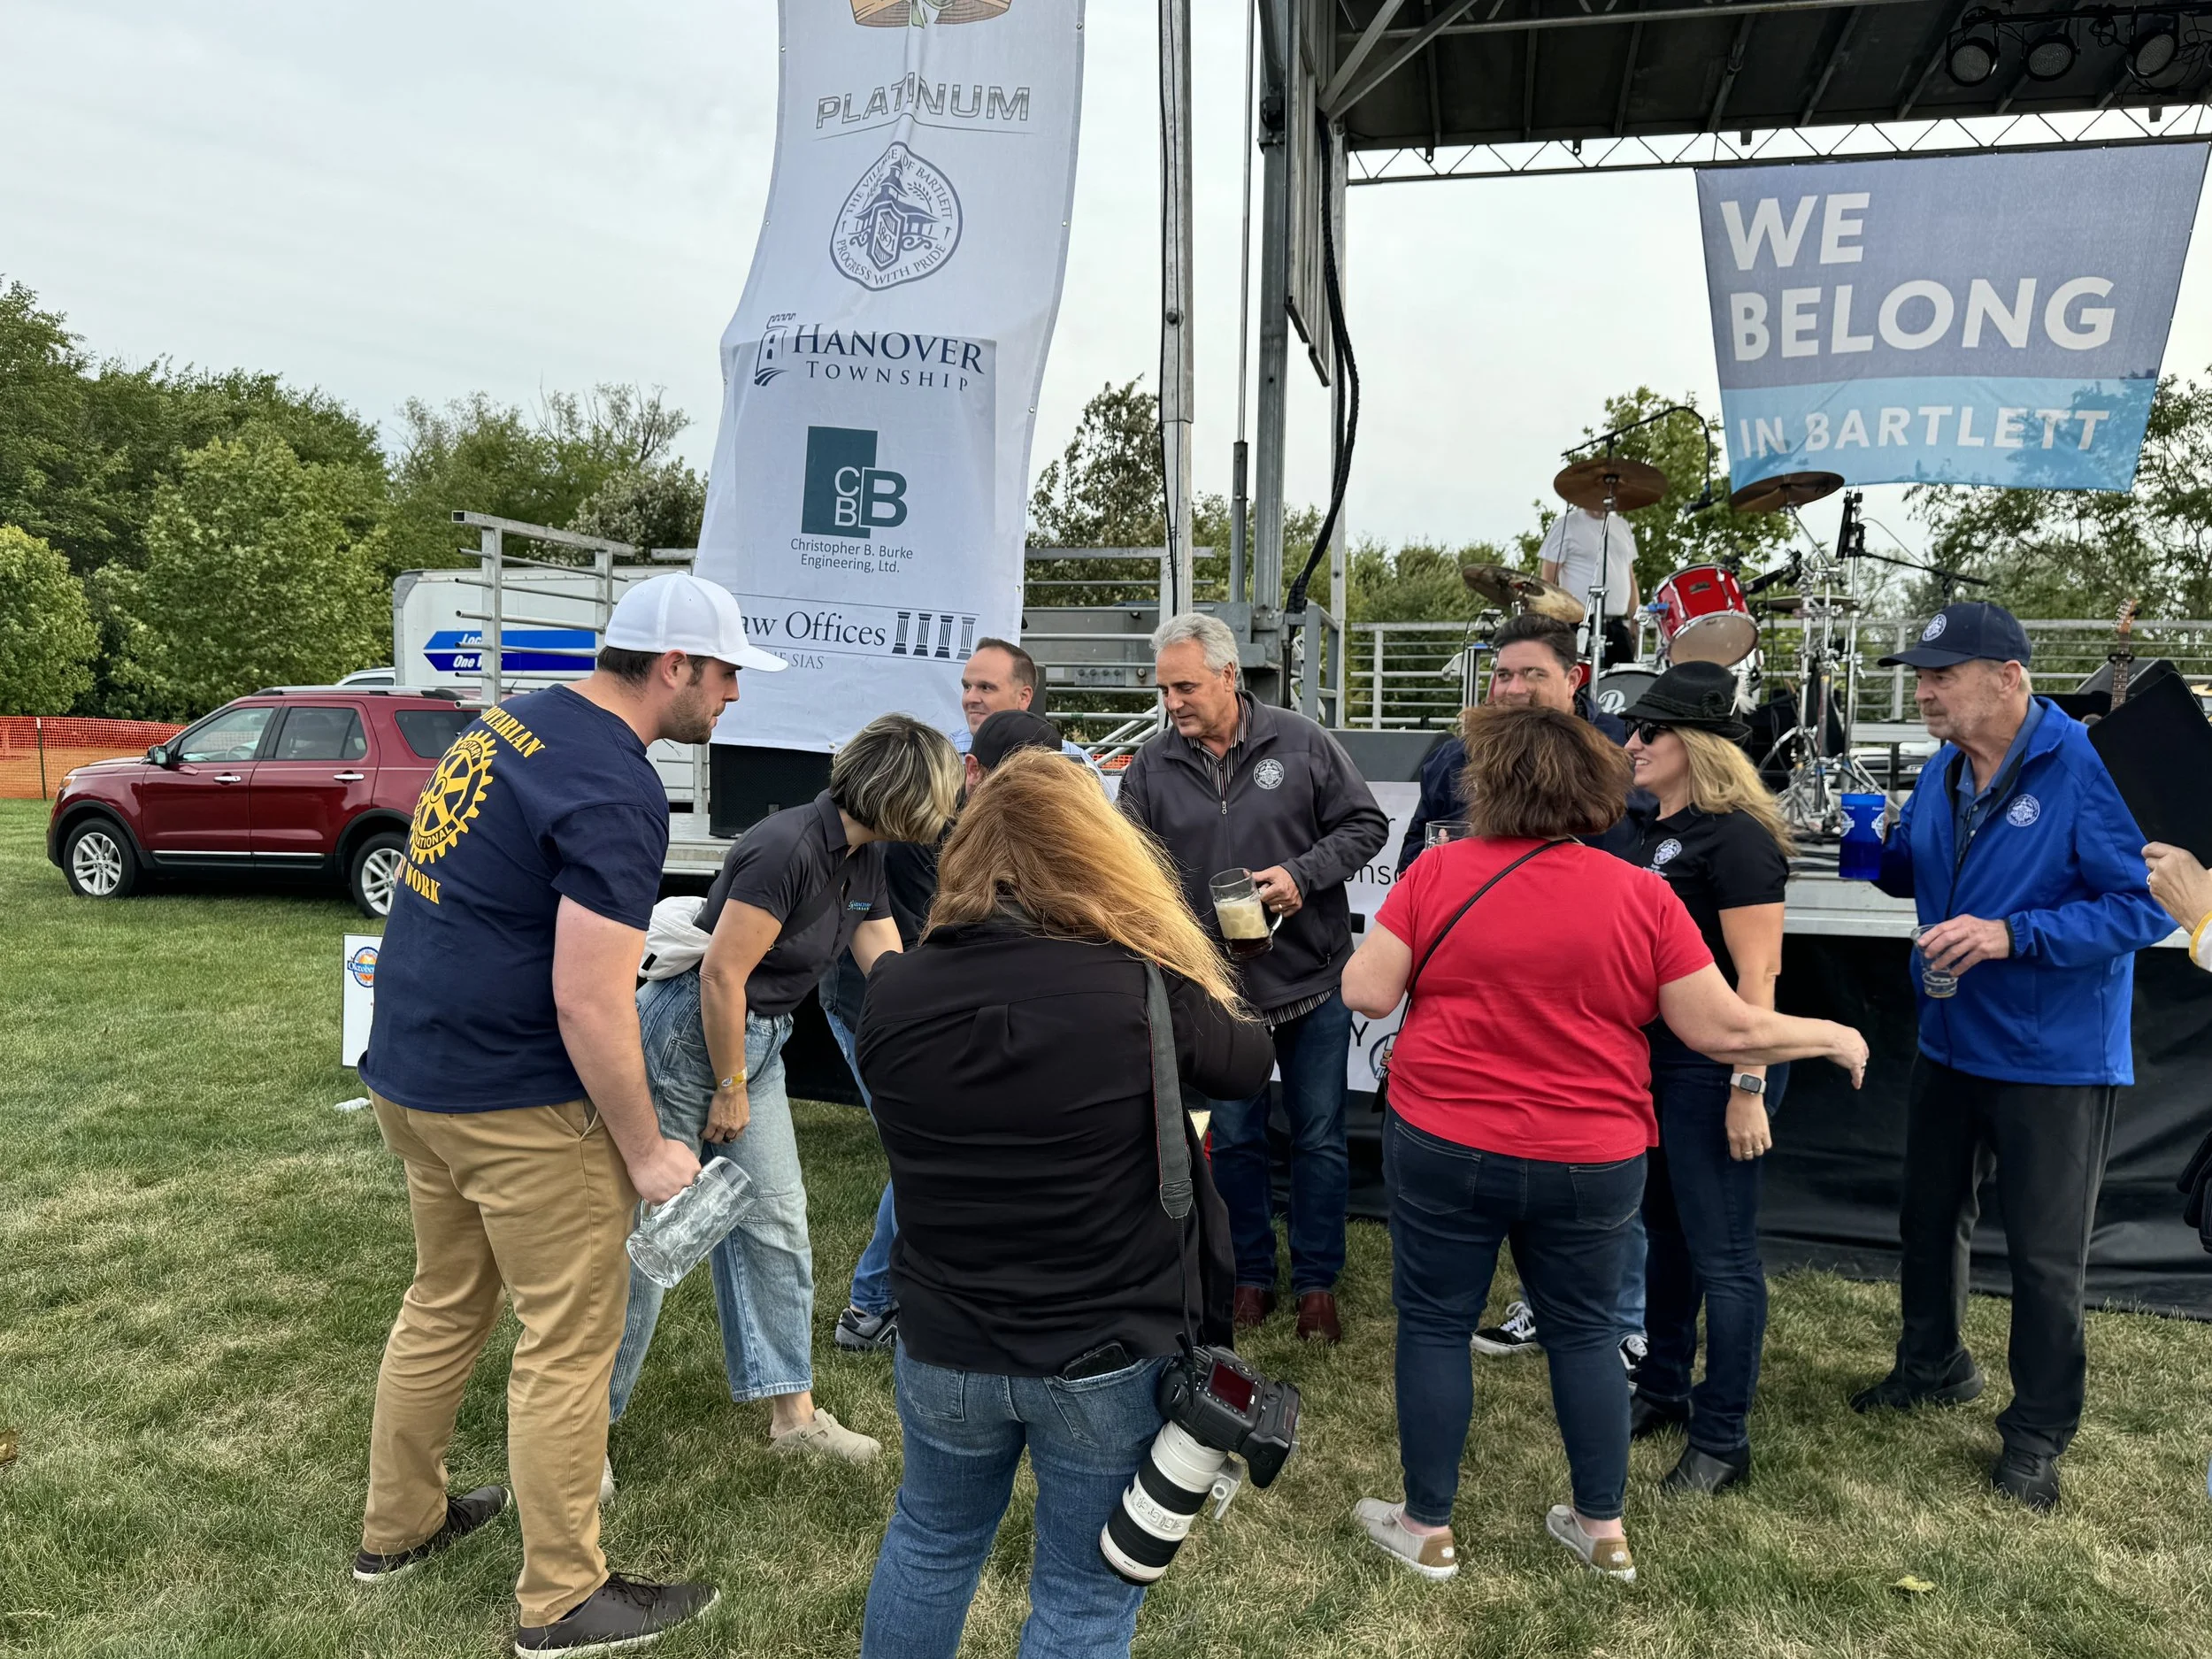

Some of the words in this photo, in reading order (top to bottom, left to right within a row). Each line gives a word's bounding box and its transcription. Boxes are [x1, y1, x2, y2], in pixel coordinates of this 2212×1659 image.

[816, 72, 1031, 129] PLATINUM
[846, 192, 864, 215] THE
[902, 154, 915, 170] OF
[916, 166, 953, 219] BARTLETT
[879, 221, 895, 251] 1891
[1720, 191, 1870, 271] WE
[836, 239, 872, 280] PROGRESS
[874, 266, 910, 285] WITH
[912, 243, 946, 273] PRIDE
[1730, 276, 2116, 361] BELONG
[792, 323, 985, 374] HANOVER
[806, 360, 968, 391] TOWNSHIP
[1740, 417, 1789, 458] IN
[1805, 405, 2110, 452] BARTLETT
[790, 538, 861, 556] Christopher
[864, 544, 875, 557] B.
[879, 545, 913, 559] Burke
[801, 553, 875, 573] Engineering,
[879, 560, 900, 573] Ltd.
[741, 616, 778, 636] aw
[786, 611, 886, 646] Offices
[453, 655, 476, 668] One
[791, 653, 825, 670] SIAS
[458, 741, 481, 759] ROTARY
[480, 705, 546, 758] OTARIAN
[405, 862, 442, 905] WORK
